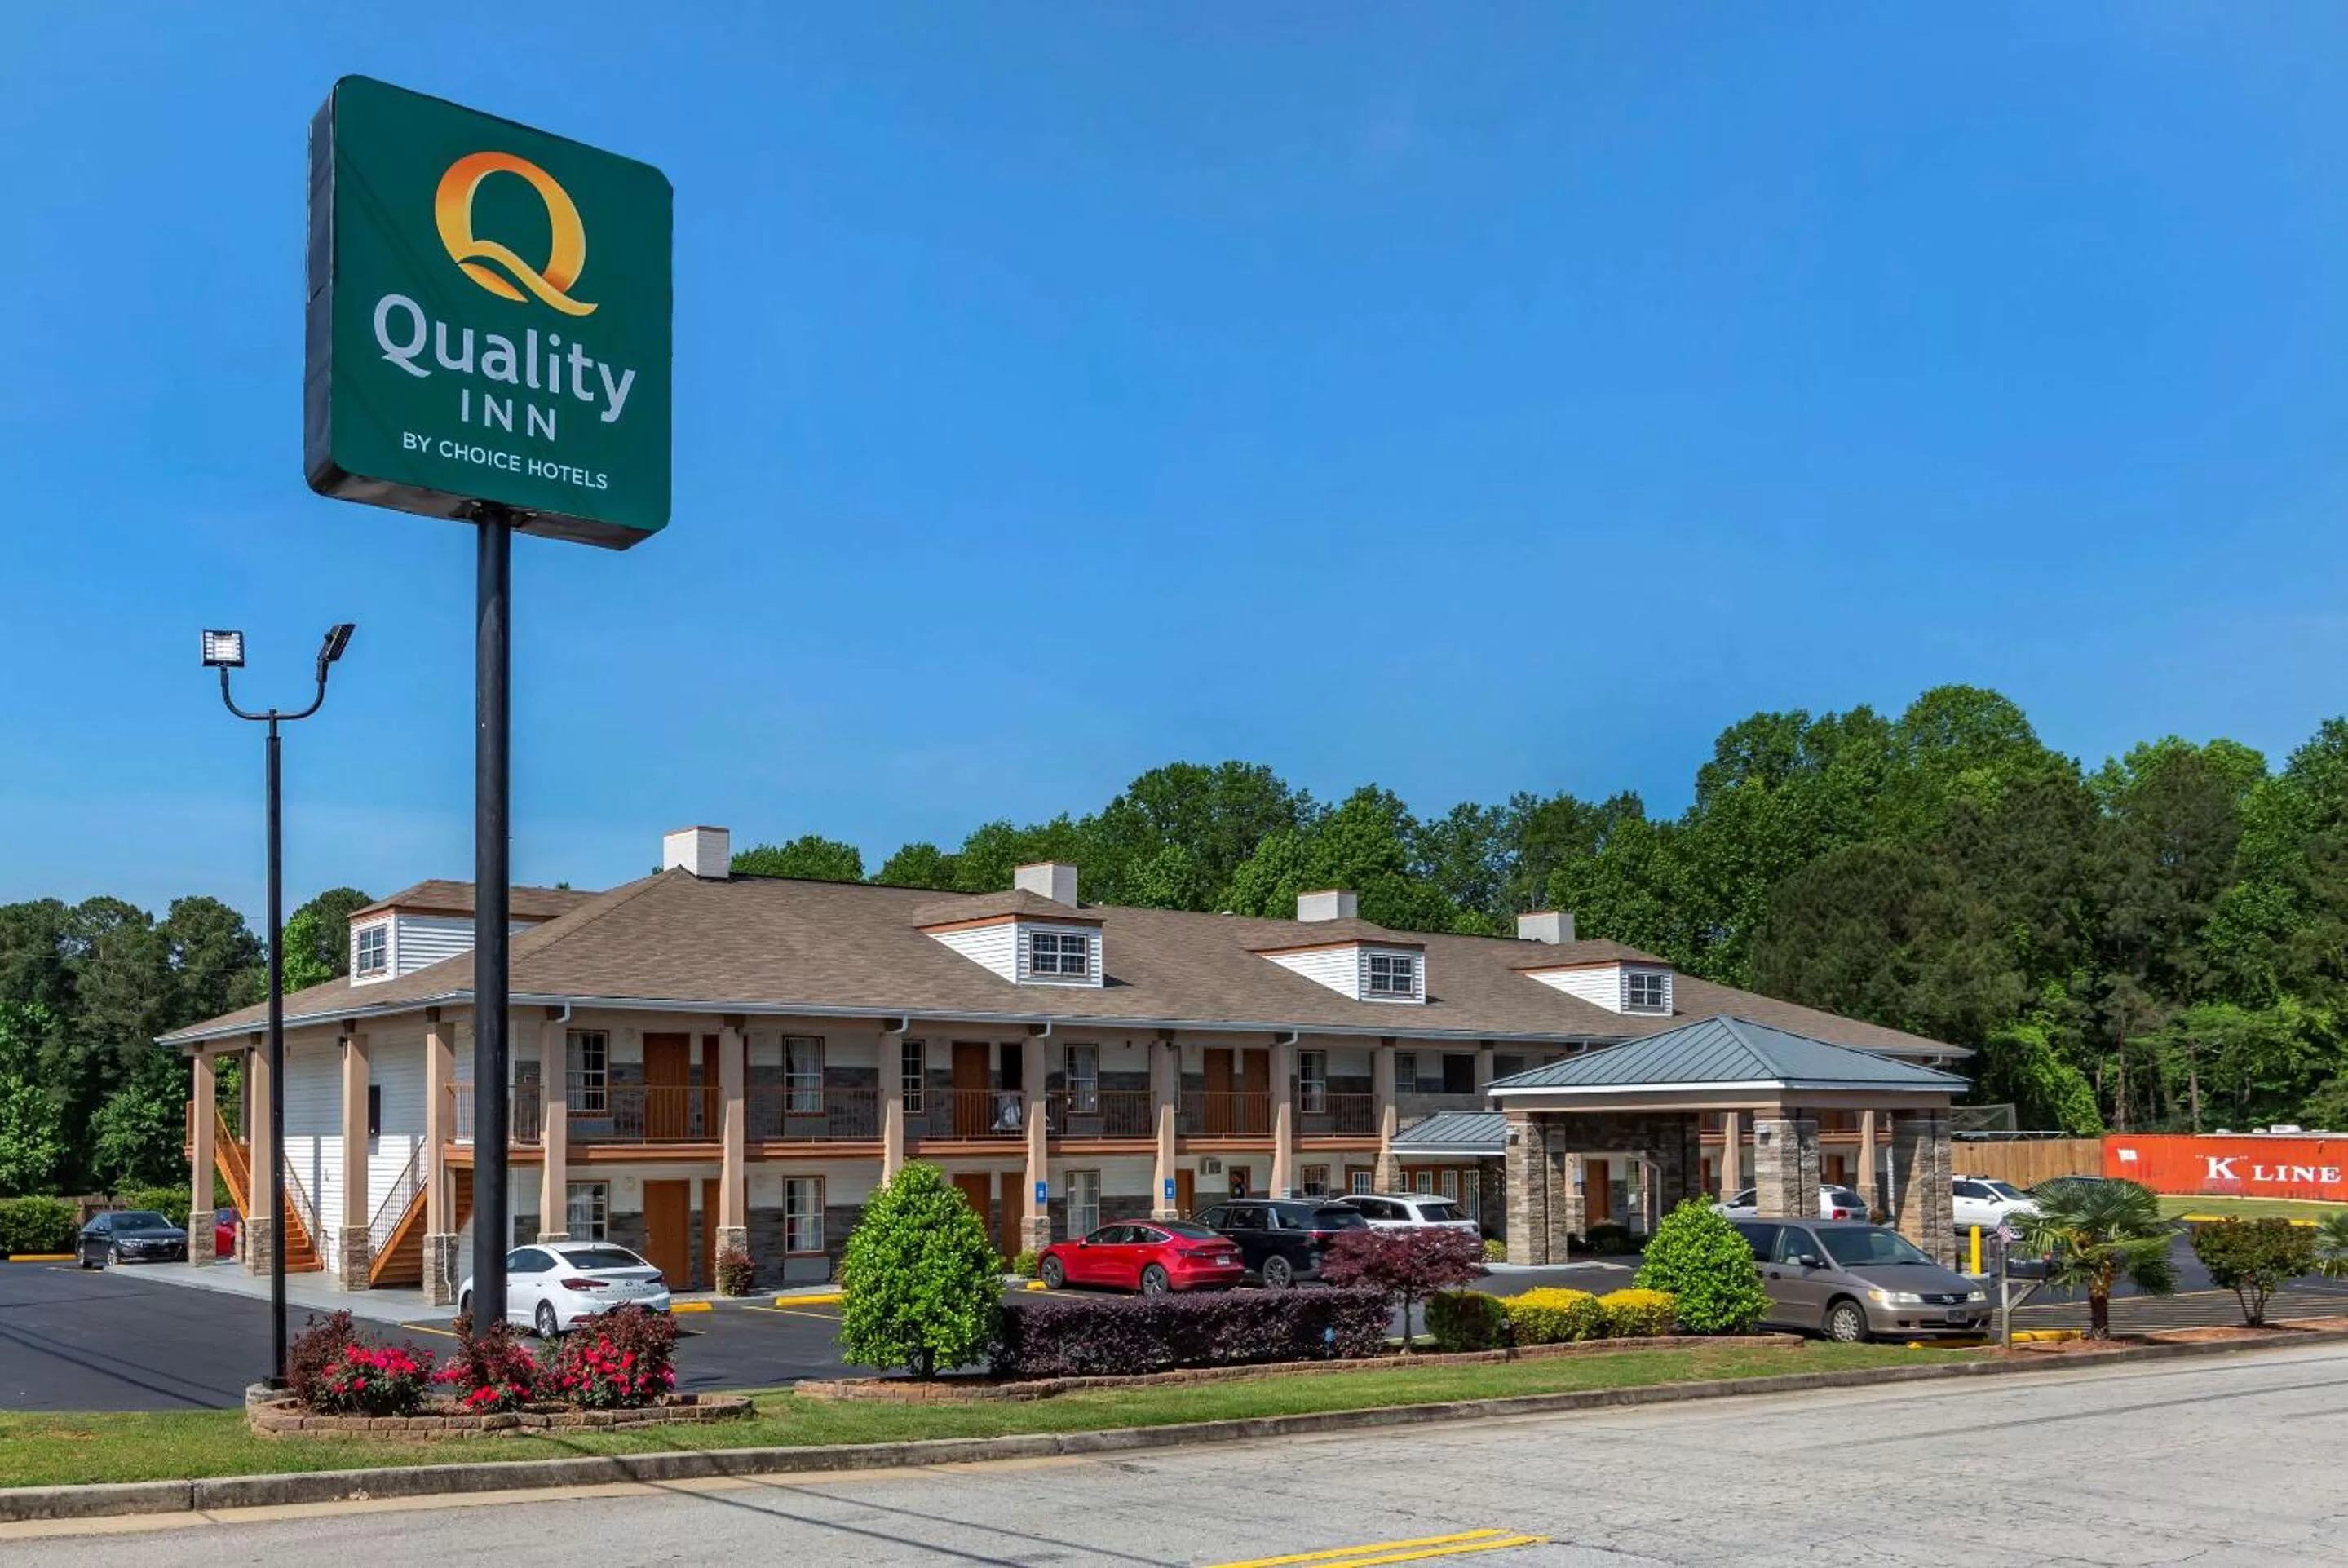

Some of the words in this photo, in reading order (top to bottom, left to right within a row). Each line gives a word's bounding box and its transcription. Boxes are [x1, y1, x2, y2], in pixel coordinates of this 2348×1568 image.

[434, 151, 599, 316] Q
[373, 294, 636, 423] Quality
[462, 389, 555, 441] INN
[403, 431, 431, 453] BY
[439, 440, 521, 472] CHOICE
[528, 459, 608, 490] HOTELS
[2253, 1164, 2342, 1183] LINE
